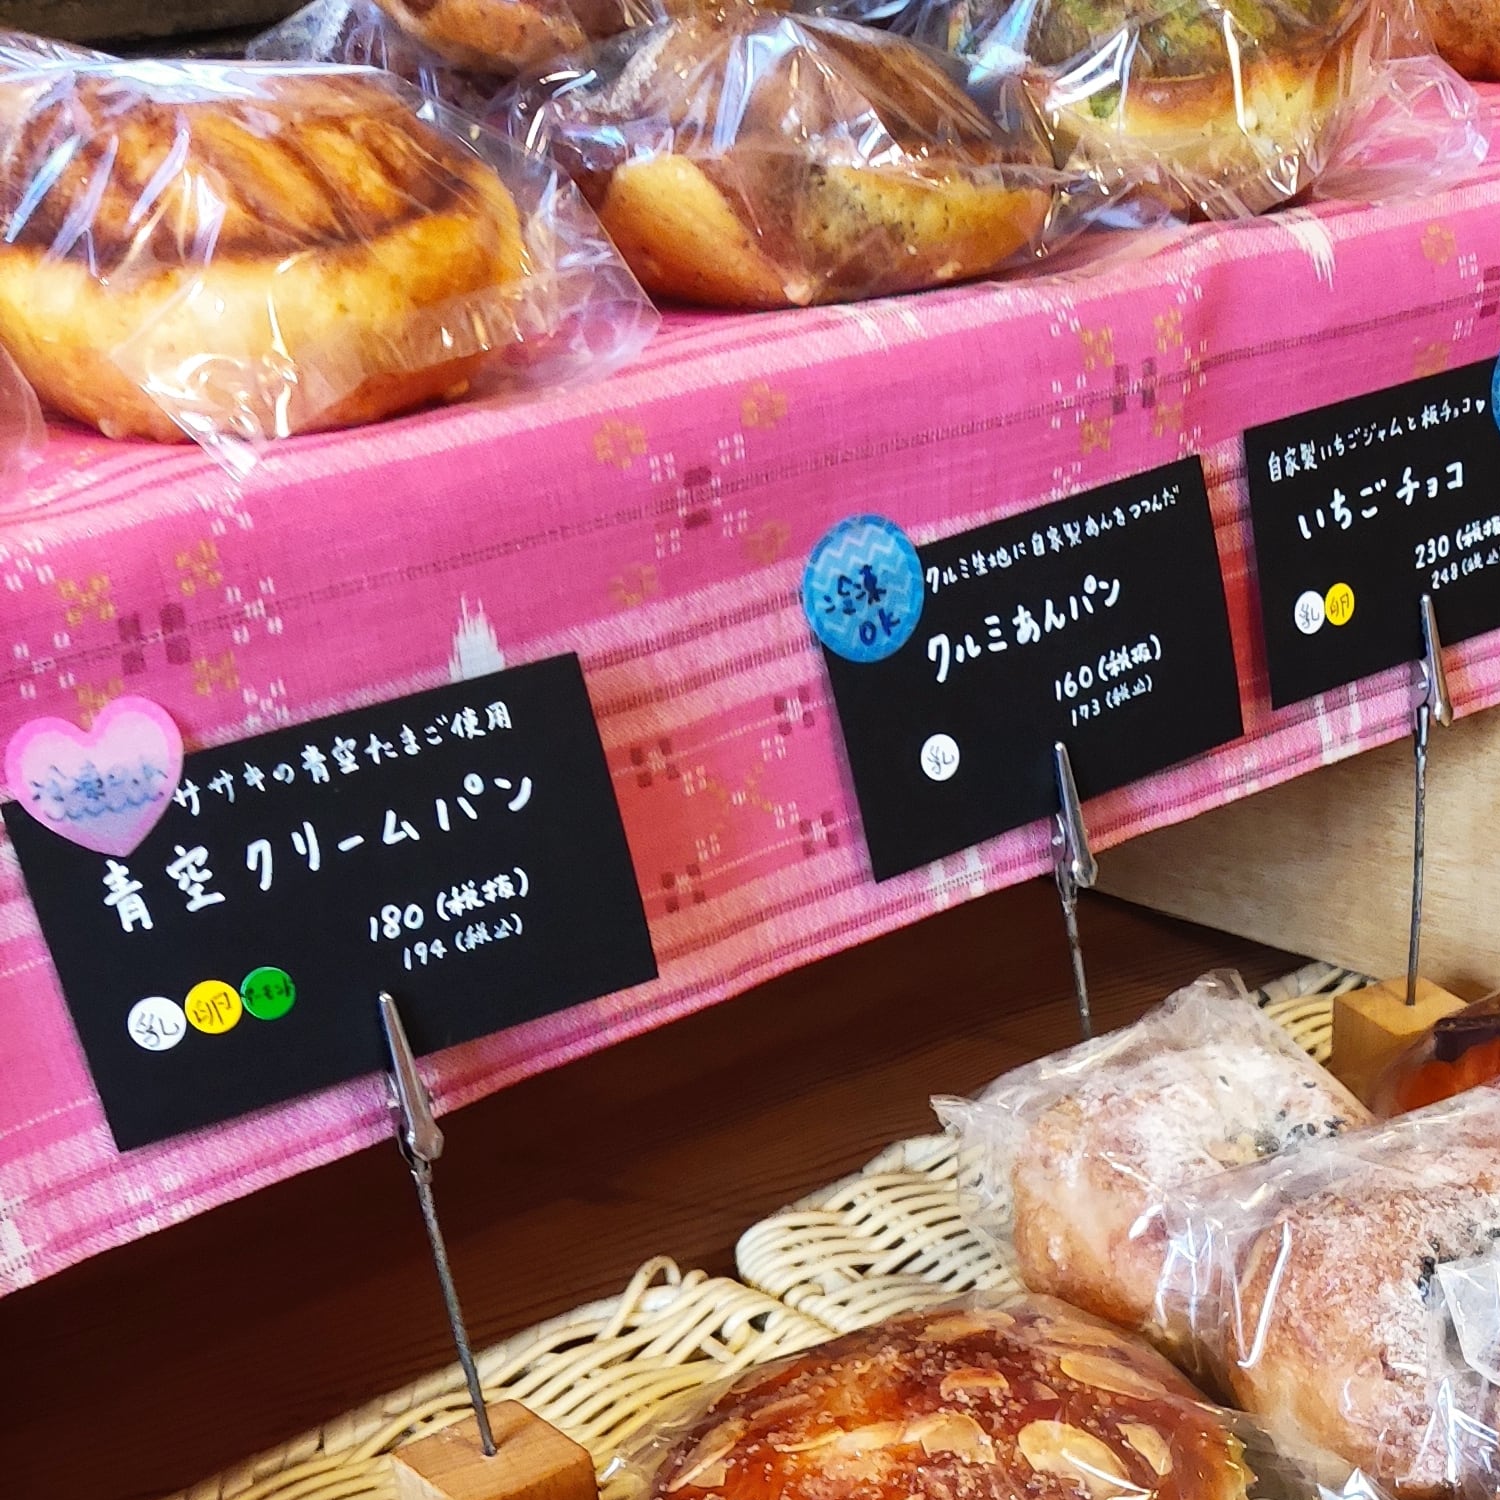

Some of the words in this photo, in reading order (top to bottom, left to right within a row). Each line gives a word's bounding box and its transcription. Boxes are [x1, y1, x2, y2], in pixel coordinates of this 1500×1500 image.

[1297, 460, 1464, 540] いちごチョコ
[858, 609, 901, 646] OK
[927, 574, 1122, 684] クルミあんパン
[173, 700, 514, 817] ササキの青空たまご使用
